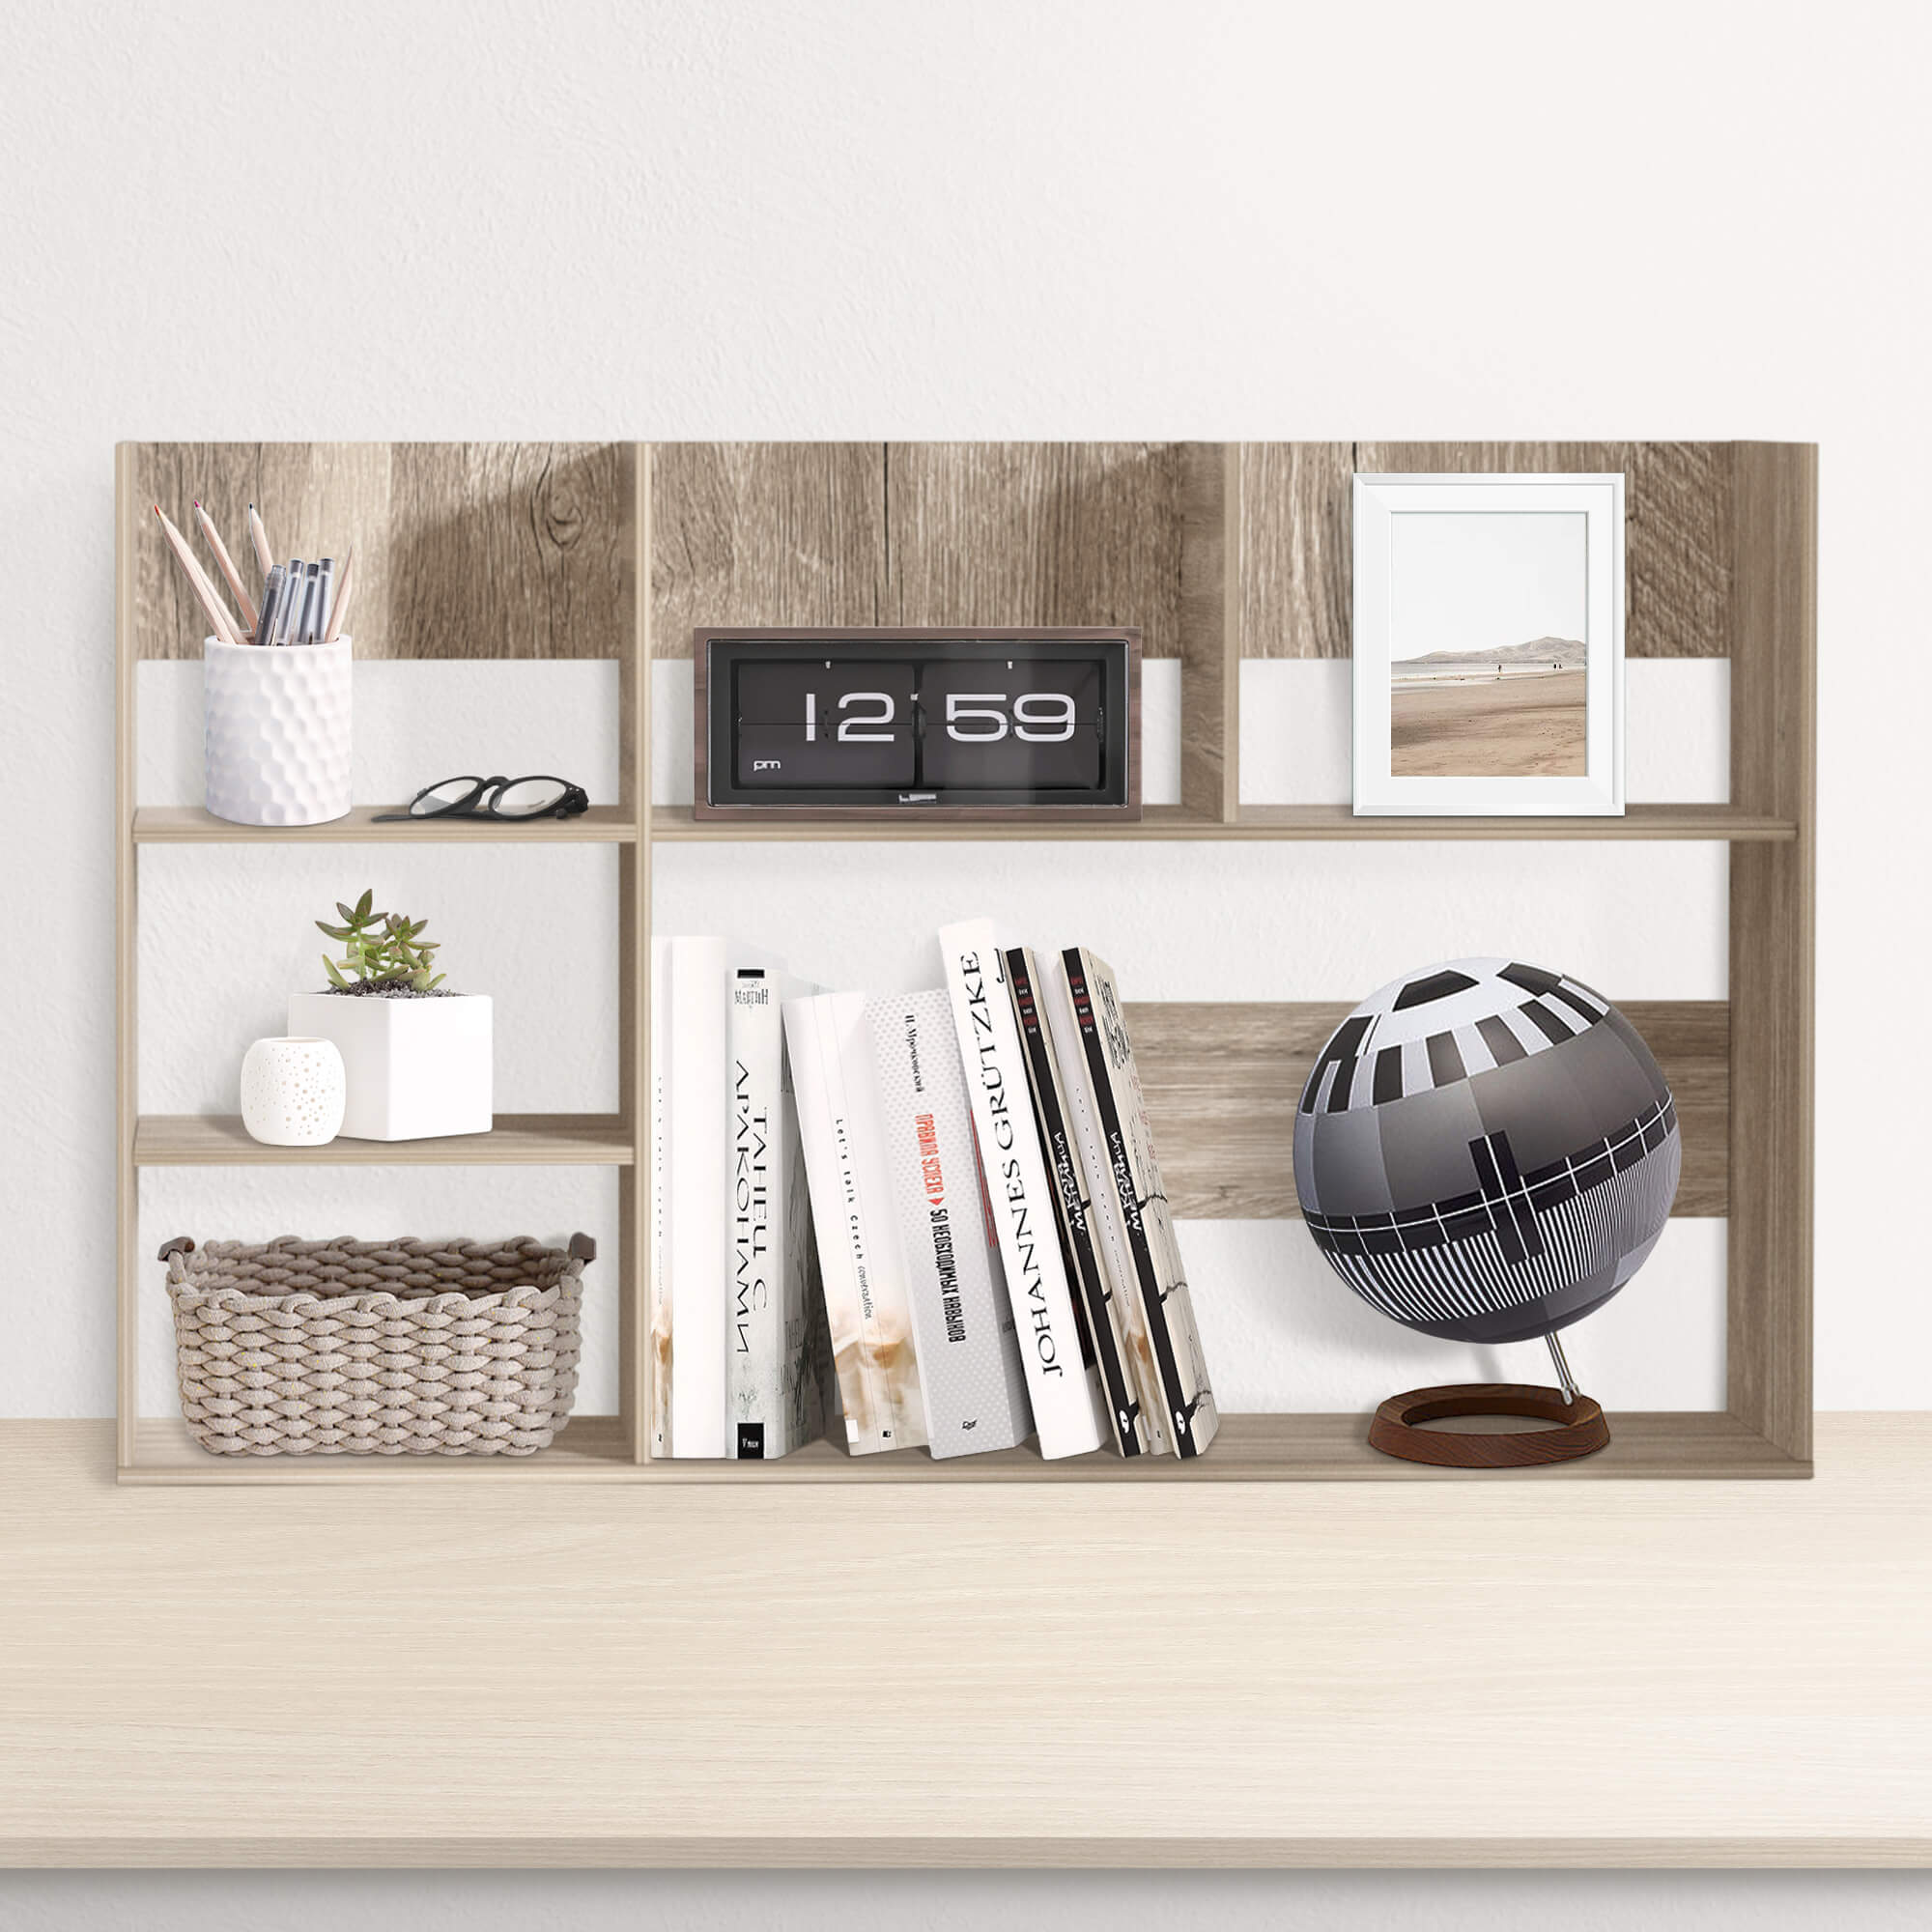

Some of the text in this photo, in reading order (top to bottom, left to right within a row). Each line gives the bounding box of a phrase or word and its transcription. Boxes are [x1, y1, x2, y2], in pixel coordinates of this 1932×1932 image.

[806, 693, 1075, 742] 12 59
[753, 759, 781, 771] pm
[960, 951, 1014, 1151] GRÜTZKE
[915, 1114, 939, 1157] ПРАВИЛА
[753, 1106, 767, 1259] ТАНЕЦ
[921, 1156, 944, 1195] УСПЕХА
[850, 1214, 865, 1260] Czech
[930, 1208, 949, 1223] 50
[932, 1223, 959, 1295] НЕОБХОДИМЫХ
[1002, 1158, 1064, 1377] JOHANNES
